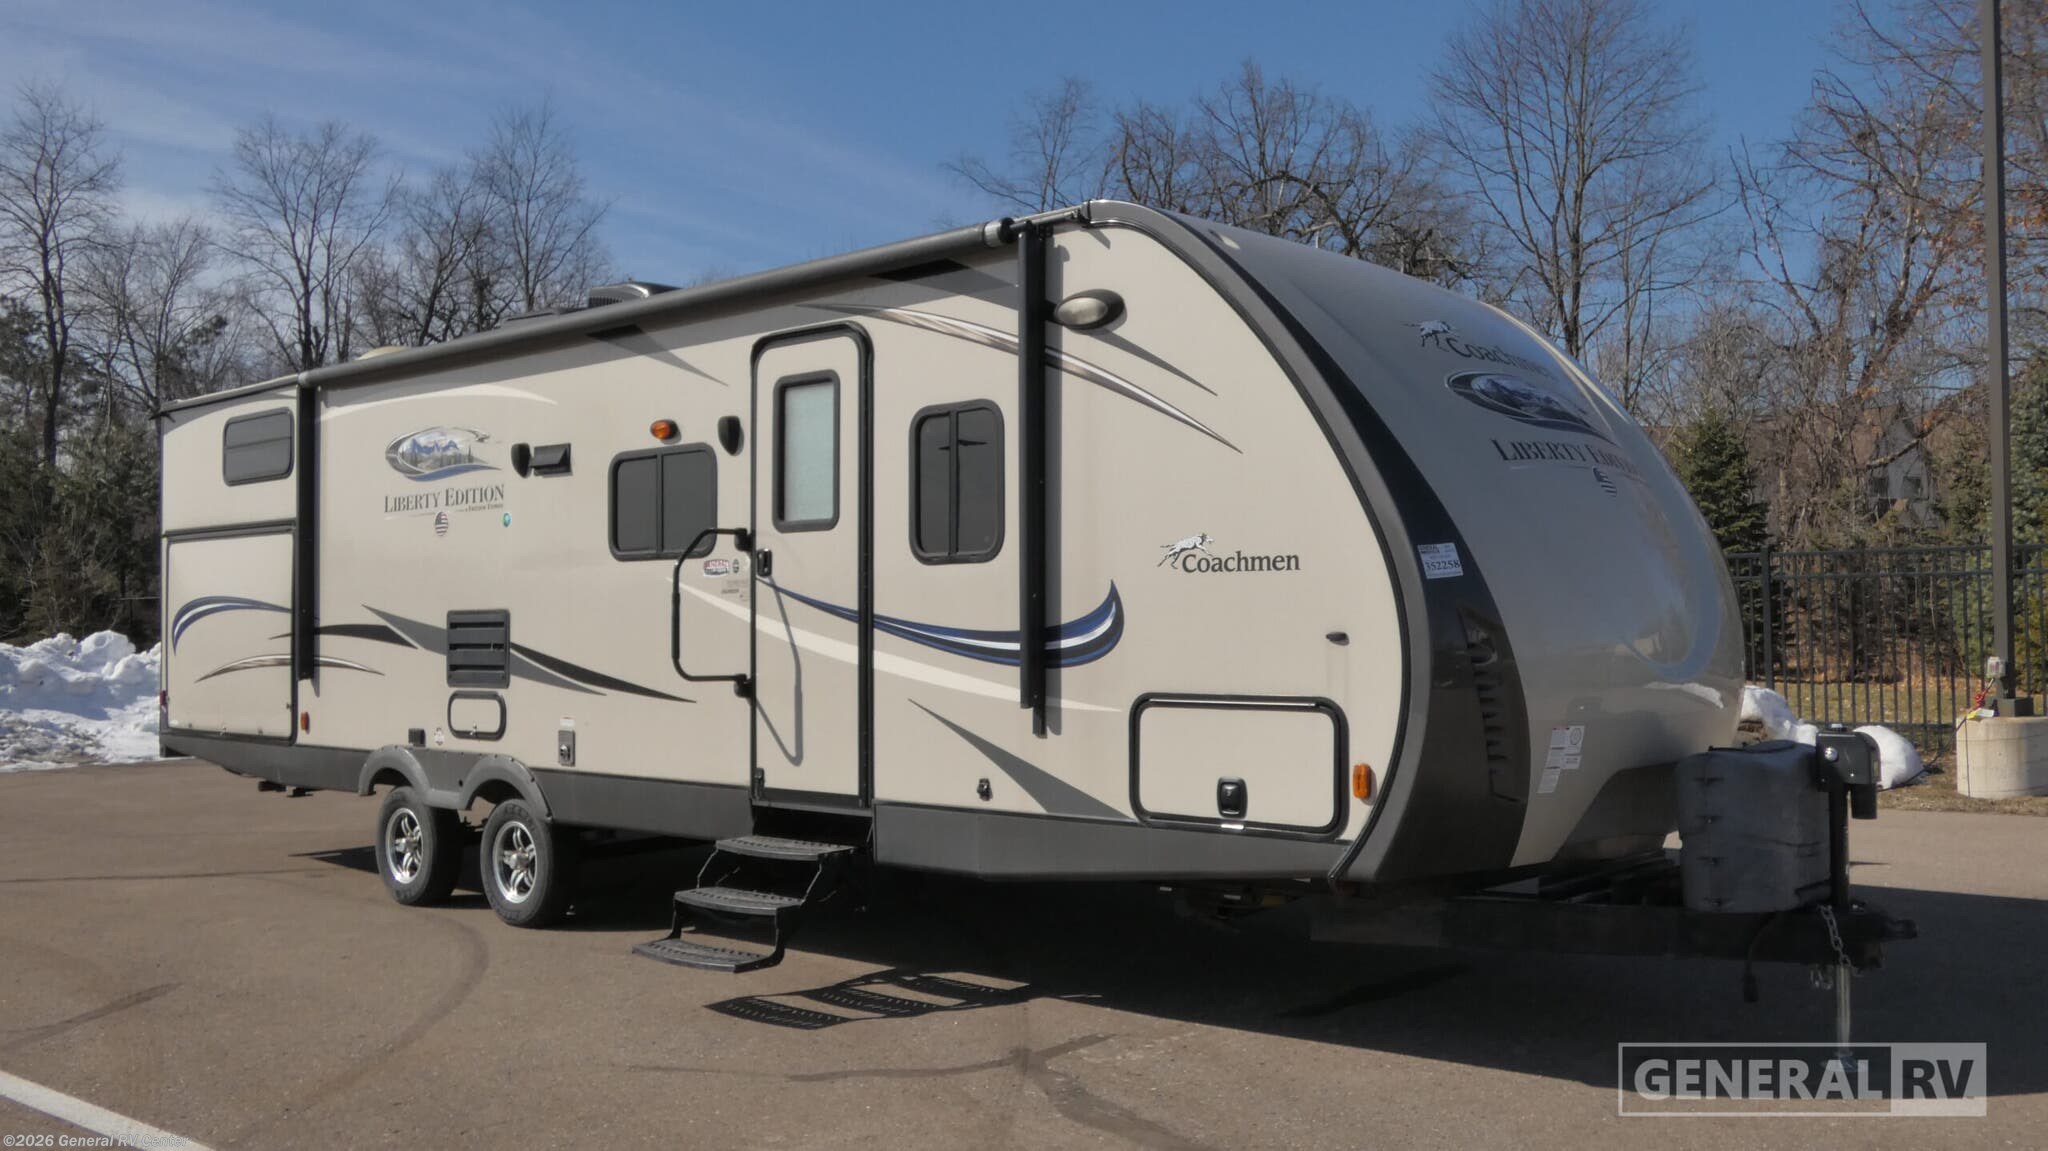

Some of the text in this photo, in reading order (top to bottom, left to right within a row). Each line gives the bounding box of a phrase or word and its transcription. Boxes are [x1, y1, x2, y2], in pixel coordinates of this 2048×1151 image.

[1491, 439, 1588, 462] LIBERTY
[384, 484, 504, 513] LIBERTY EDITION
[1182, 550, 1301, 573] Coachmen
